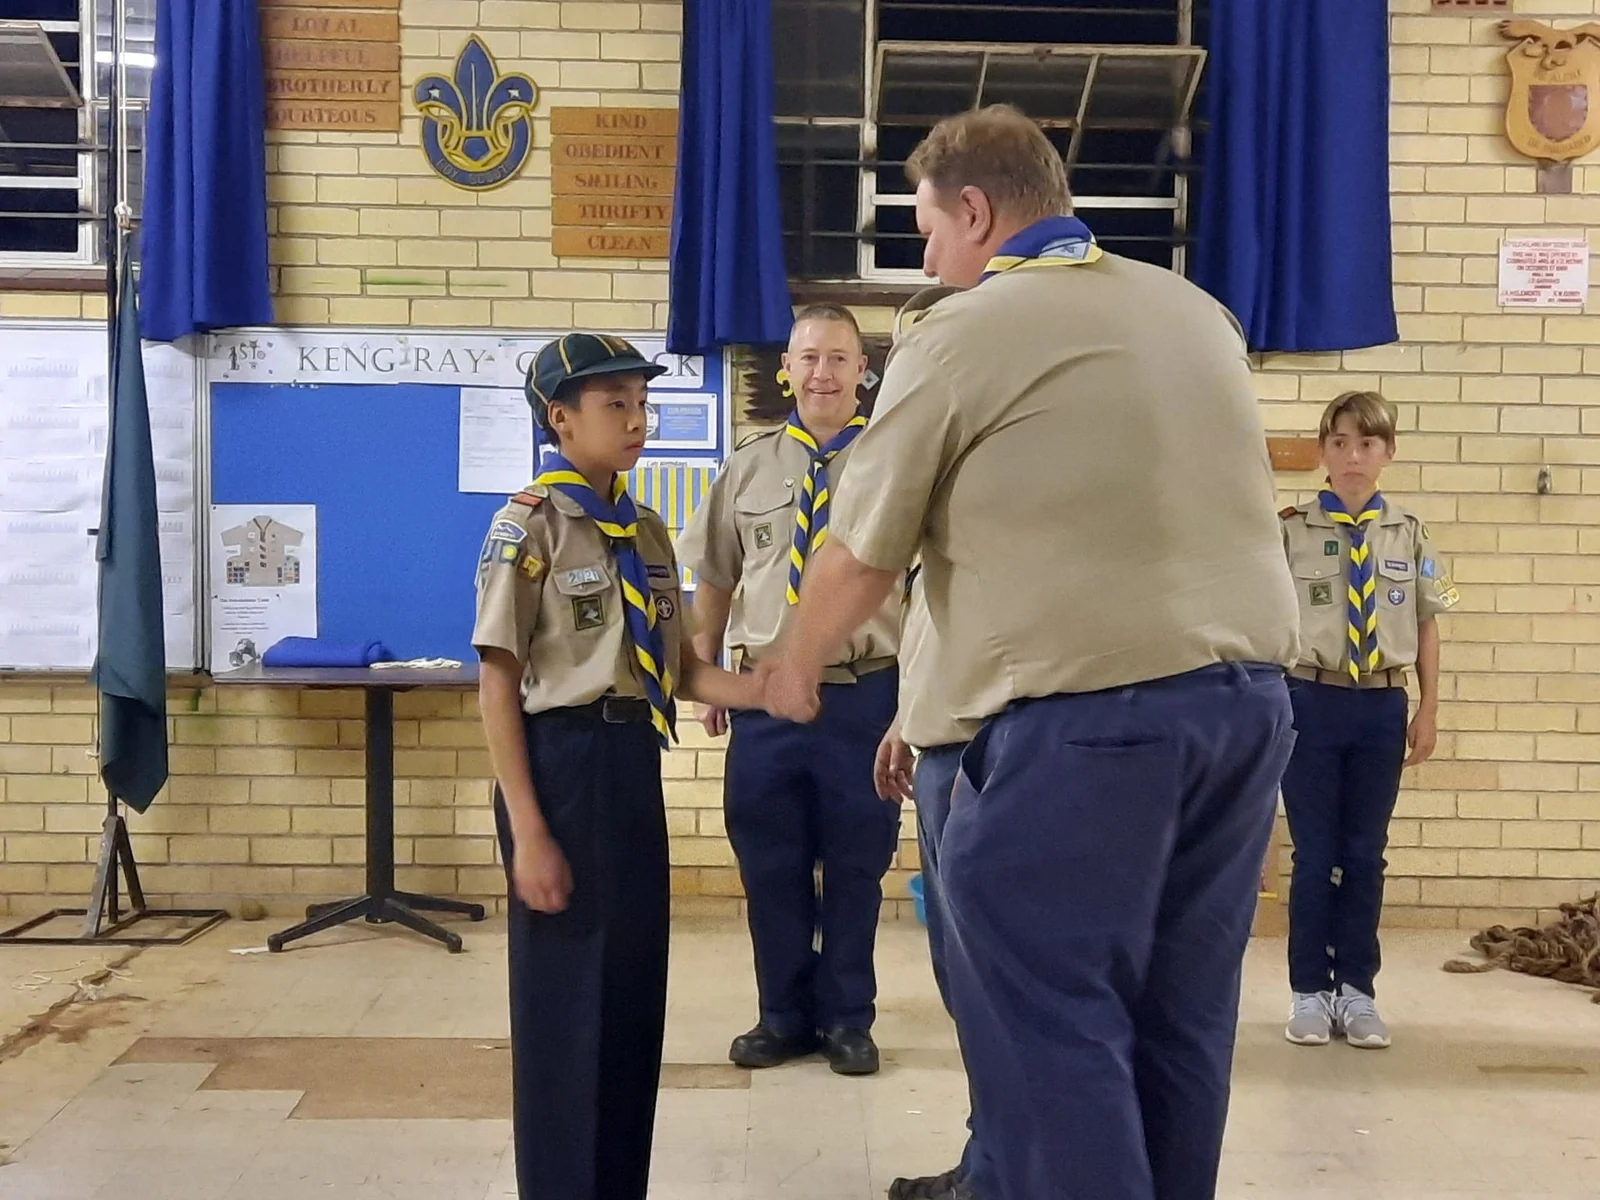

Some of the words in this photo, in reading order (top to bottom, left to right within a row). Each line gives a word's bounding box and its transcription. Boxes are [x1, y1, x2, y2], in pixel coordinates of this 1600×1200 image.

[291, 18, 362, 34] LOYAL
[267, 78, 391, 94] BROTHERLY
[274, 107, 376, 123] OURTEOUS
[595, 113, 647, 129] KIND
[565, 143, 665, 160] OBEDIENT
[574, 172, 659, 189] SMILING
[578, 204, 669, 220] THRIFTY
[587, 234, 652, 250] CLEAN
[299, 346, 395, 373] KENG
[413, 347, 487, 374] RAY
